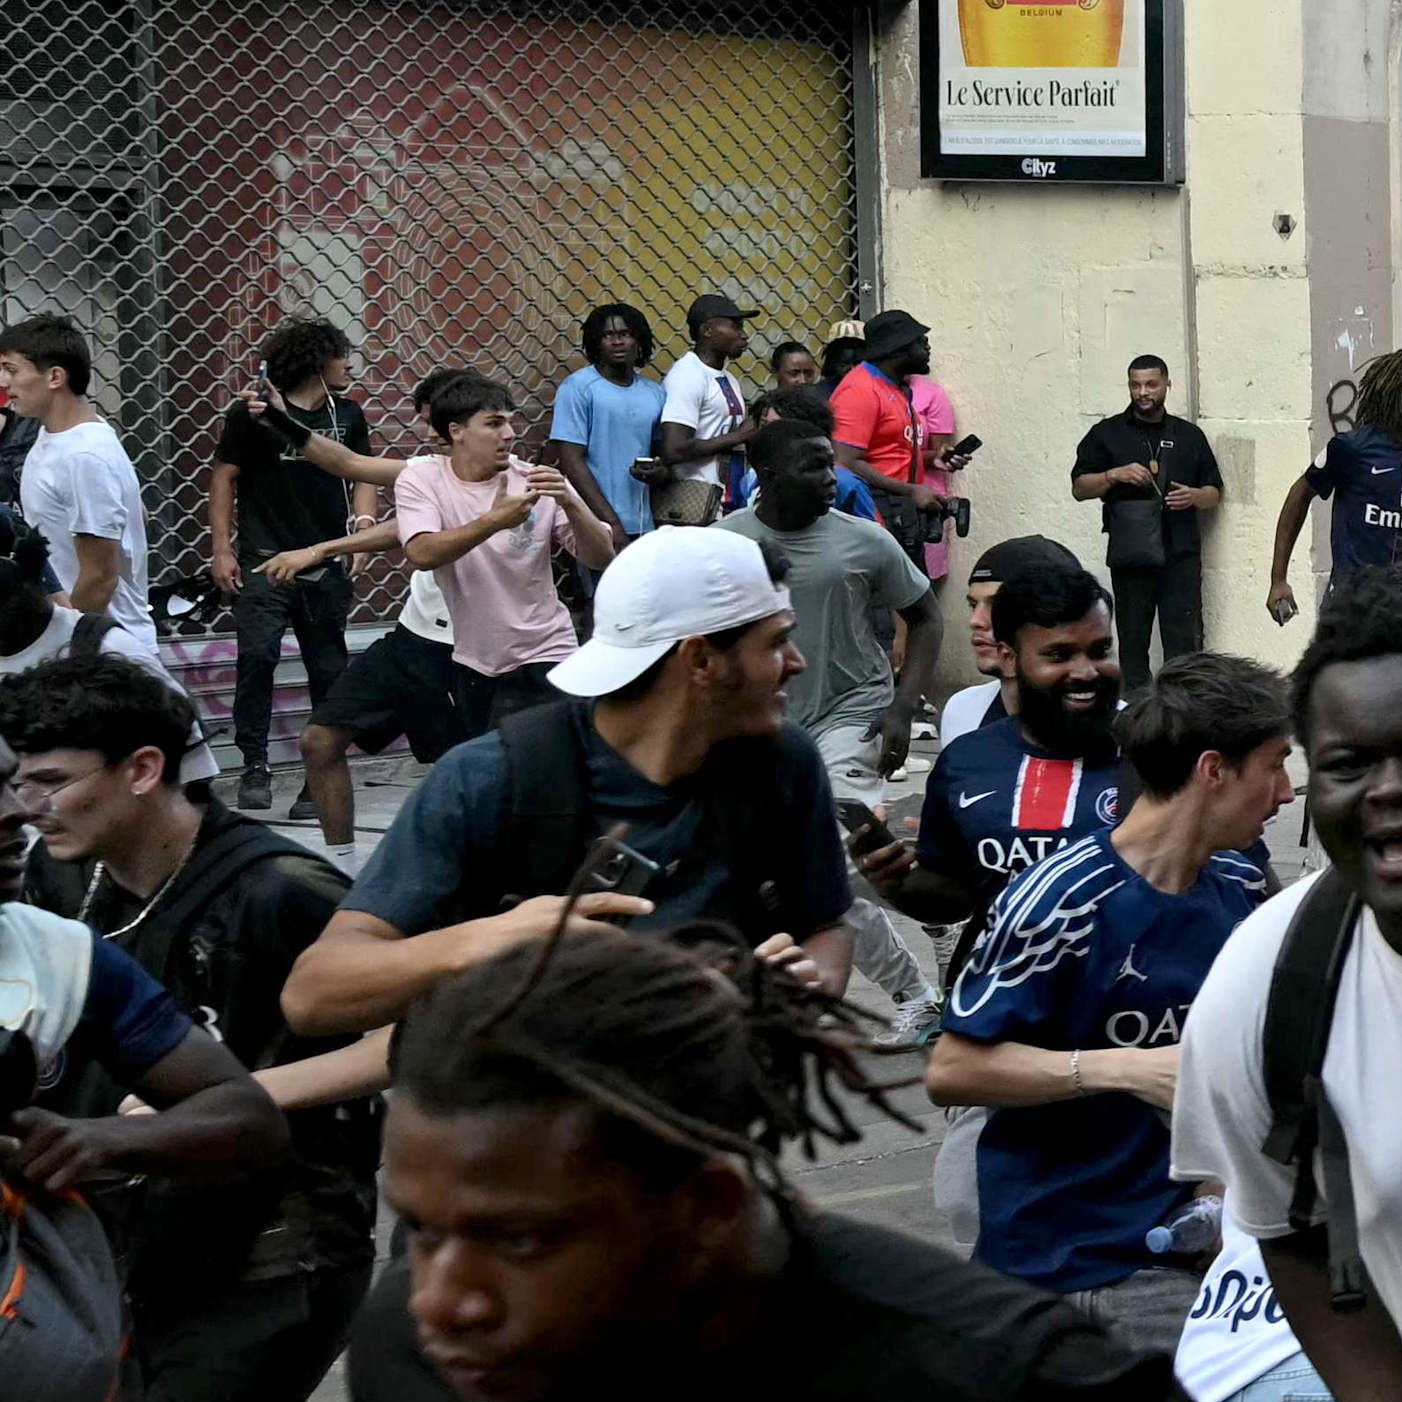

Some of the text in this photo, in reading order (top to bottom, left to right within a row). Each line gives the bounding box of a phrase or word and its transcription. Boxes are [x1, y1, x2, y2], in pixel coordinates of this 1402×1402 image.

[947, 79, 1116, 107] Le Service Parfait
[1021, 157, 1056, 177] Cityz
